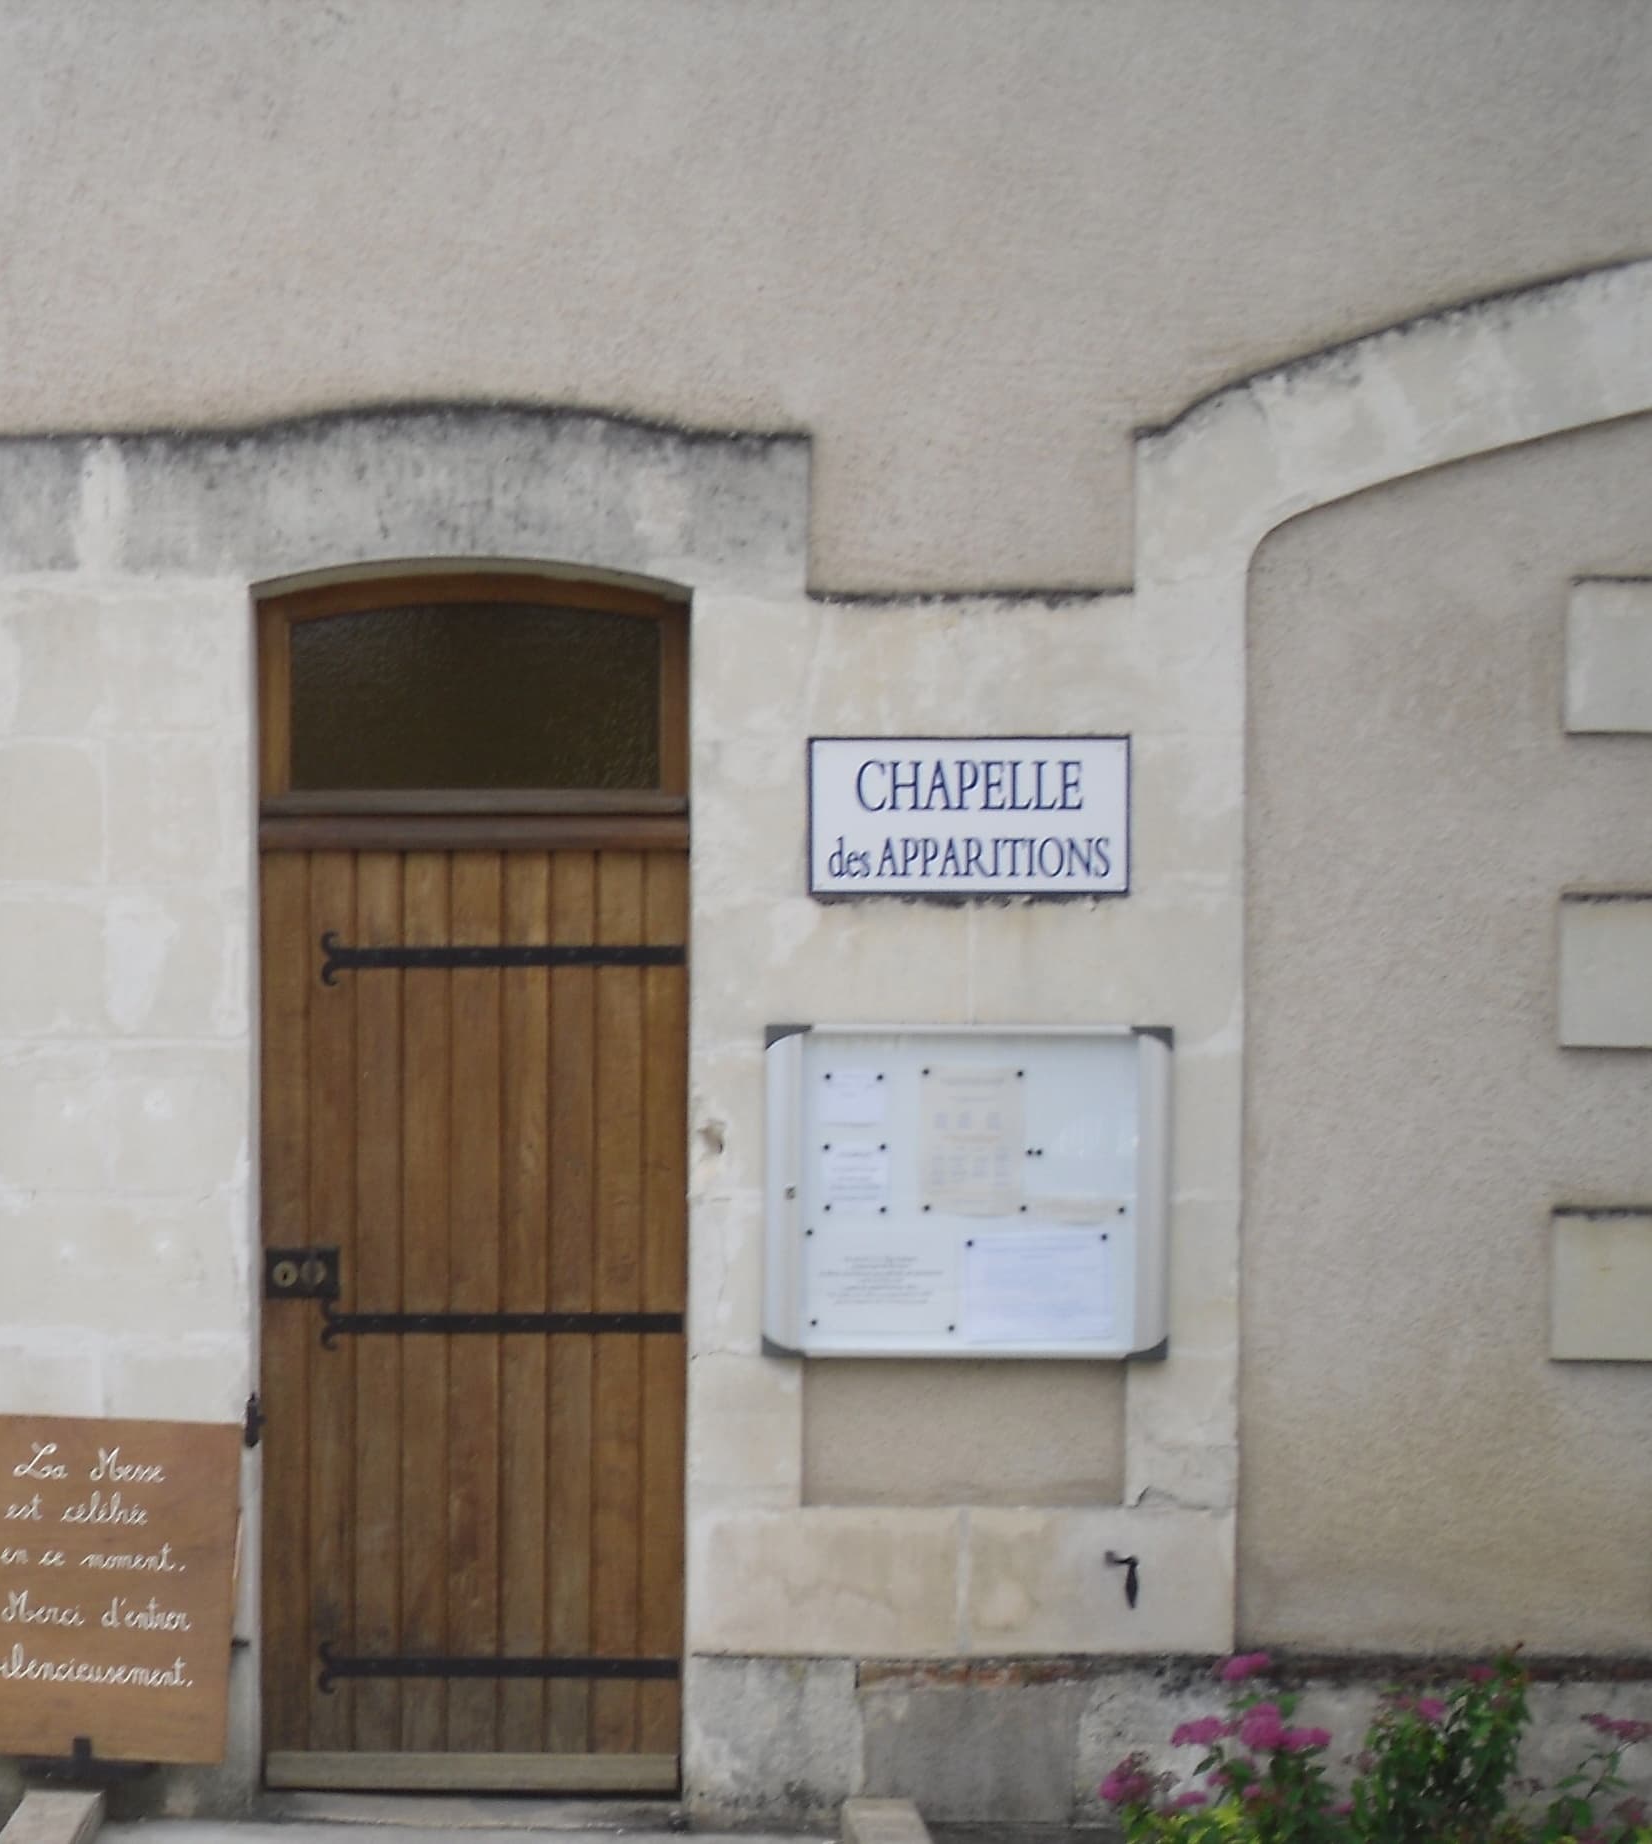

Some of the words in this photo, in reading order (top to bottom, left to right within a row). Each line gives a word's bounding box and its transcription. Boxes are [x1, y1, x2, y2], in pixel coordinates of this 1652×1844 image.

[856, 759, 1084, 812] CHAPELLE
[828, 835, 871, 879] des
[876, 836, 1111, 879] APPARITIONS
[13, 1441, 69, 1481] La
[89, 1445, 166, 1484] Messe
[3, 1493, 43, 1521] est
[0, 1545, 29, 1565] en
[38, 1549, 66, 1567] ce
[79, 1542, 186, 1573] moment.
[1, 1589, 85, 1627] Merci
[101, 1596, 192, 1632] d'entrer
